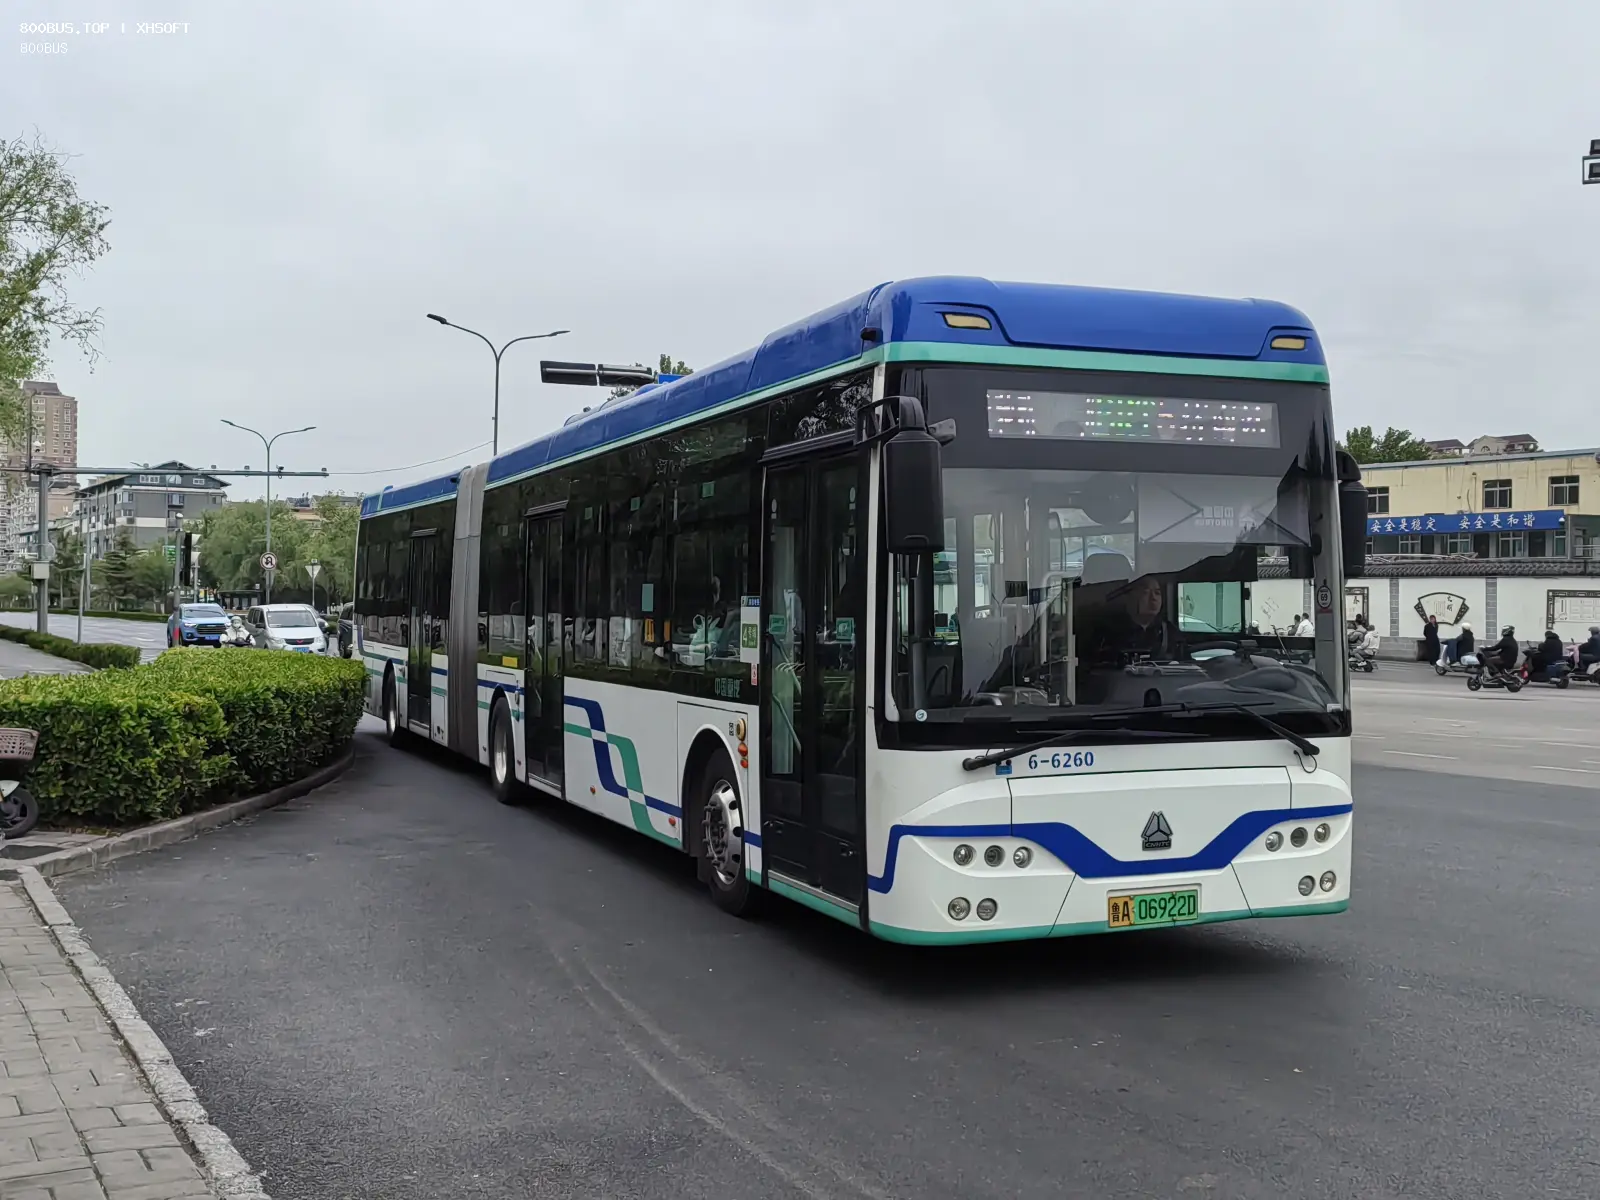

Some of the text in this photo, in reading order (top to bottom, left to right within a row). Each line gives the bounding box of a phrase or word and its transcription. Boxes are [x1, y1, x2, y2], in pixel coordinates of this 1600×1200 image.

[1370, 512, 1536, 533] 安全是稳定 安全是和谐
[1028, 751, 1094, 770] 6-6260
[1111, 894, 1196, 922] 鲁A 06922D
